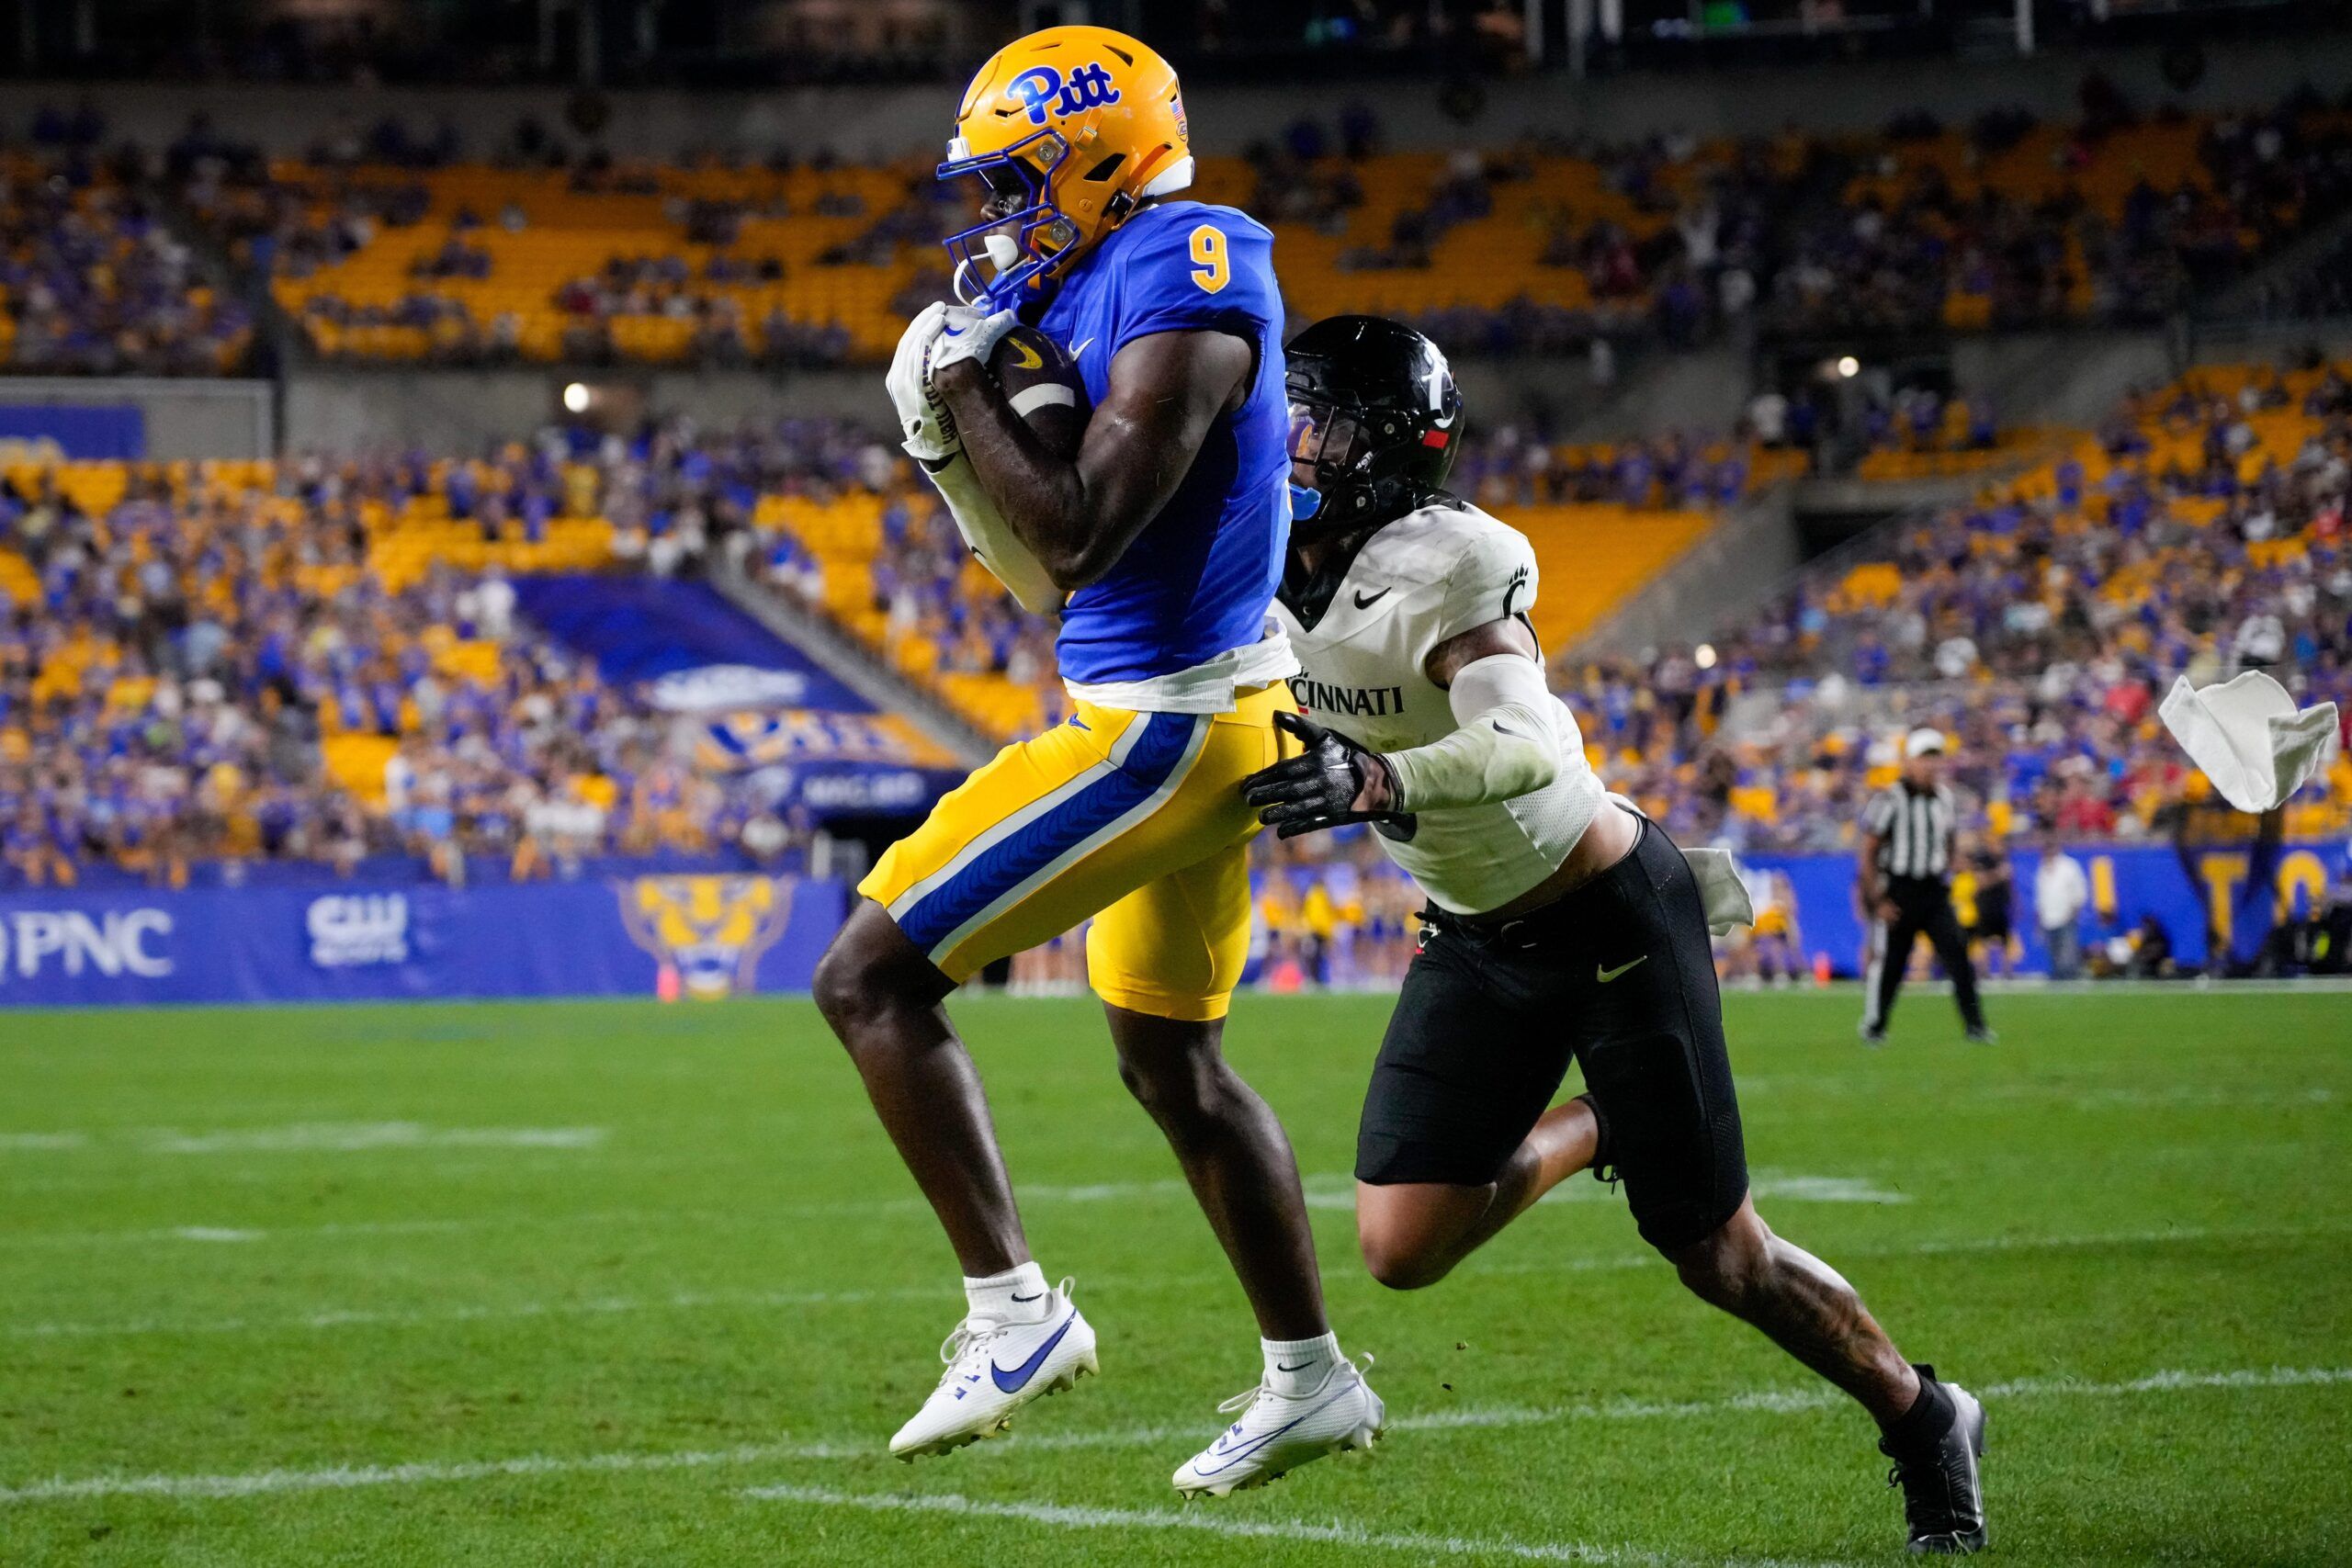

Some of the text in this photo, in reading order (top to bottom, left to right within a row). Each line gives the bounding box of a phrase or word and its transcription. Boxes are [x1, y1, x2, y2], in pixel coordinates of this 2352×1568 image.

[1006, 62, 1121, 125] Pitt
[1189, 223, 1231, 295] 9
[1286, 679, 1404, 716] CINNATI
[17, 908, 174, 977] PNC
